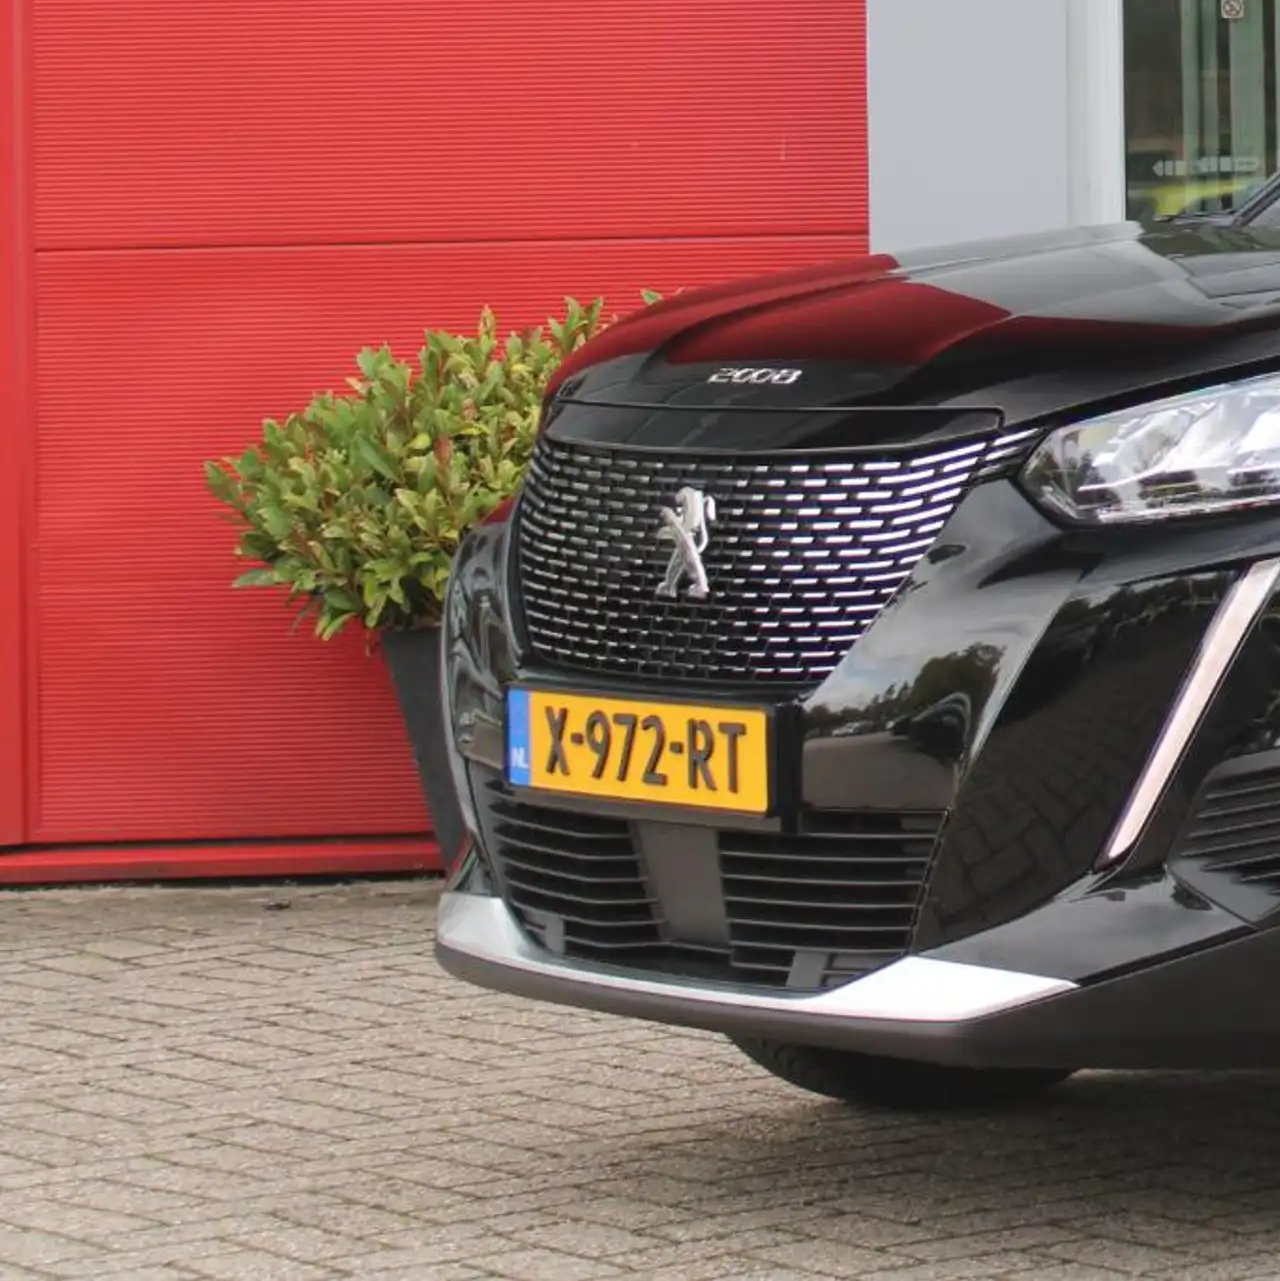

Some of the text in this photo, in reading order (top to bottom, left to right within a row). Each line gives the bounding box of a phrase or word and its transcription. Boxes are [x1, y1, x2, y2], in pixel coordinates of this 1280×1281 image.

[707, 367, 803, 384] 2008
[510, 746, 530, 769] NL
[544, 705, 747, 794] X-972-RT
